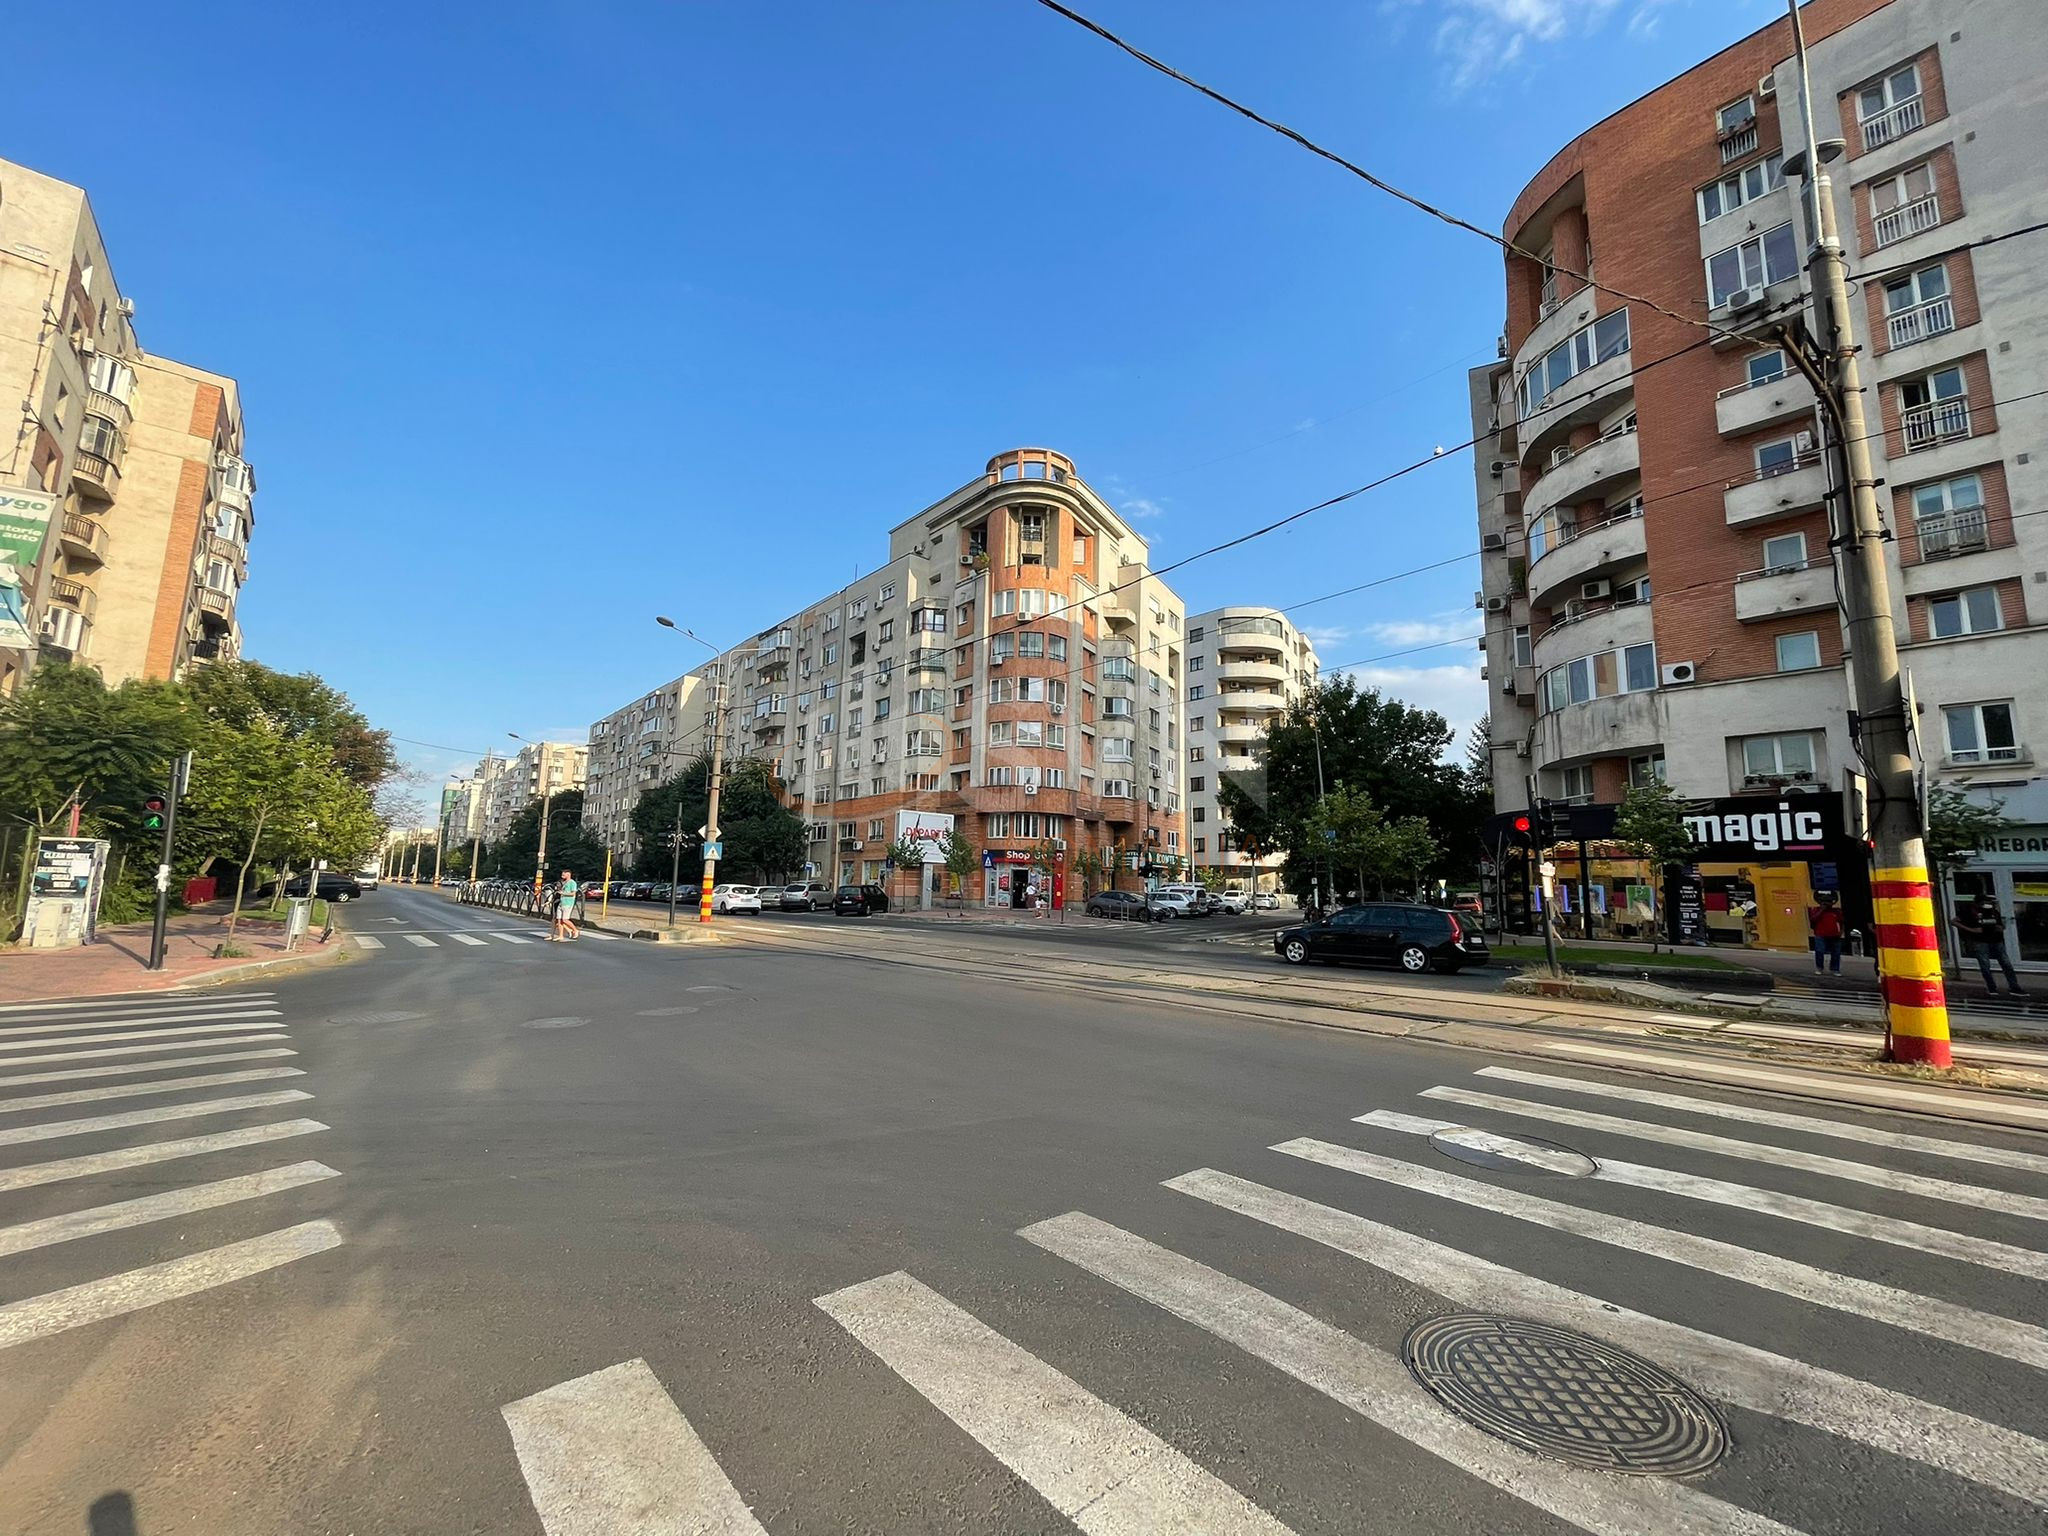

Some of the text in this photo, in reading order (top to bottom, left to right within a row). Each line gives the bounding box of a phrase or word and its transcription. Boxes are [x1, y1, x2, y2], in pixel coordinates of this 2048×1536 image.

[2, 532, 39, 543] auto
[1682, 802, 1824, 851] magic
[1006, 850, 1031, 861] Shop
